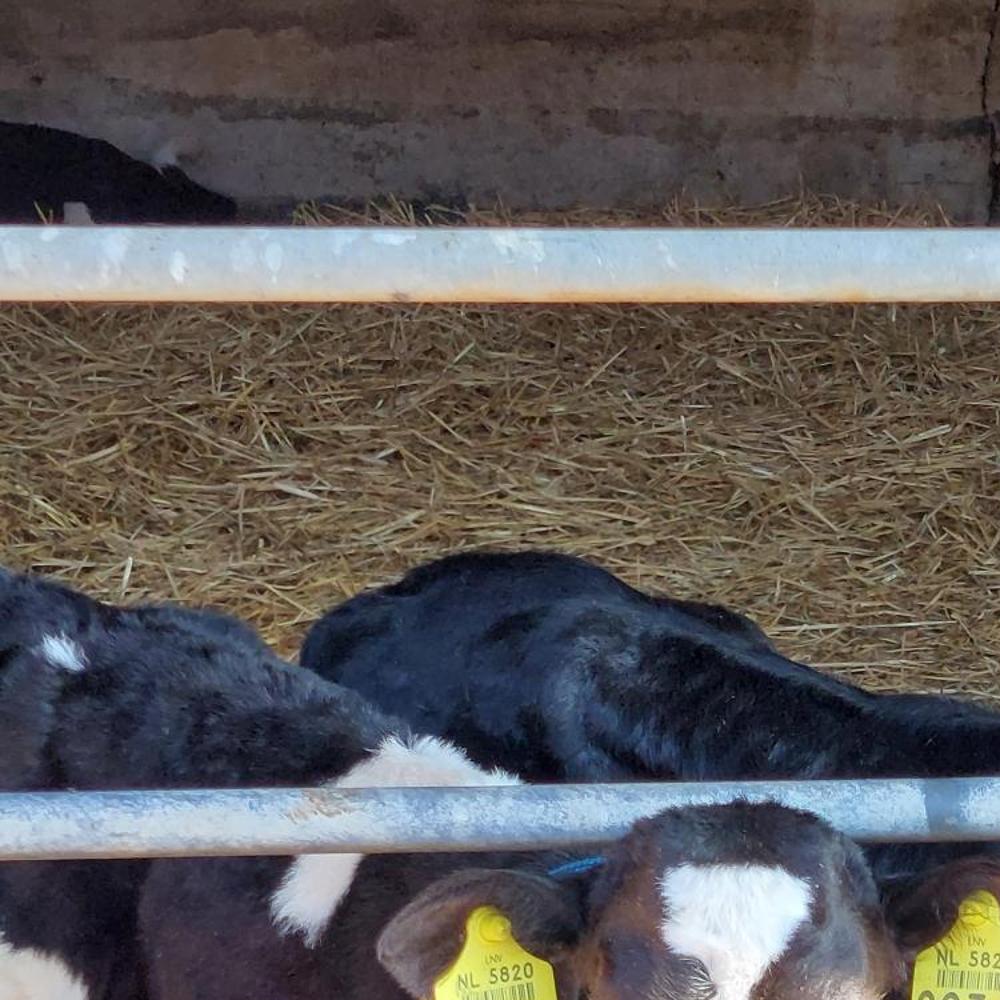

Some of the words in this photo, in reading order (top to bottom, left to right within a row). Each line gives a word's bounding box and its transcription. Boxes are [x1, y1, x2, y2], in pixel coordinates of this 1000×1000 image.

[936, 950, 959, 967] NL
[457, 972, 480, 991] NL
[489, 962, 534, 985] 5820
